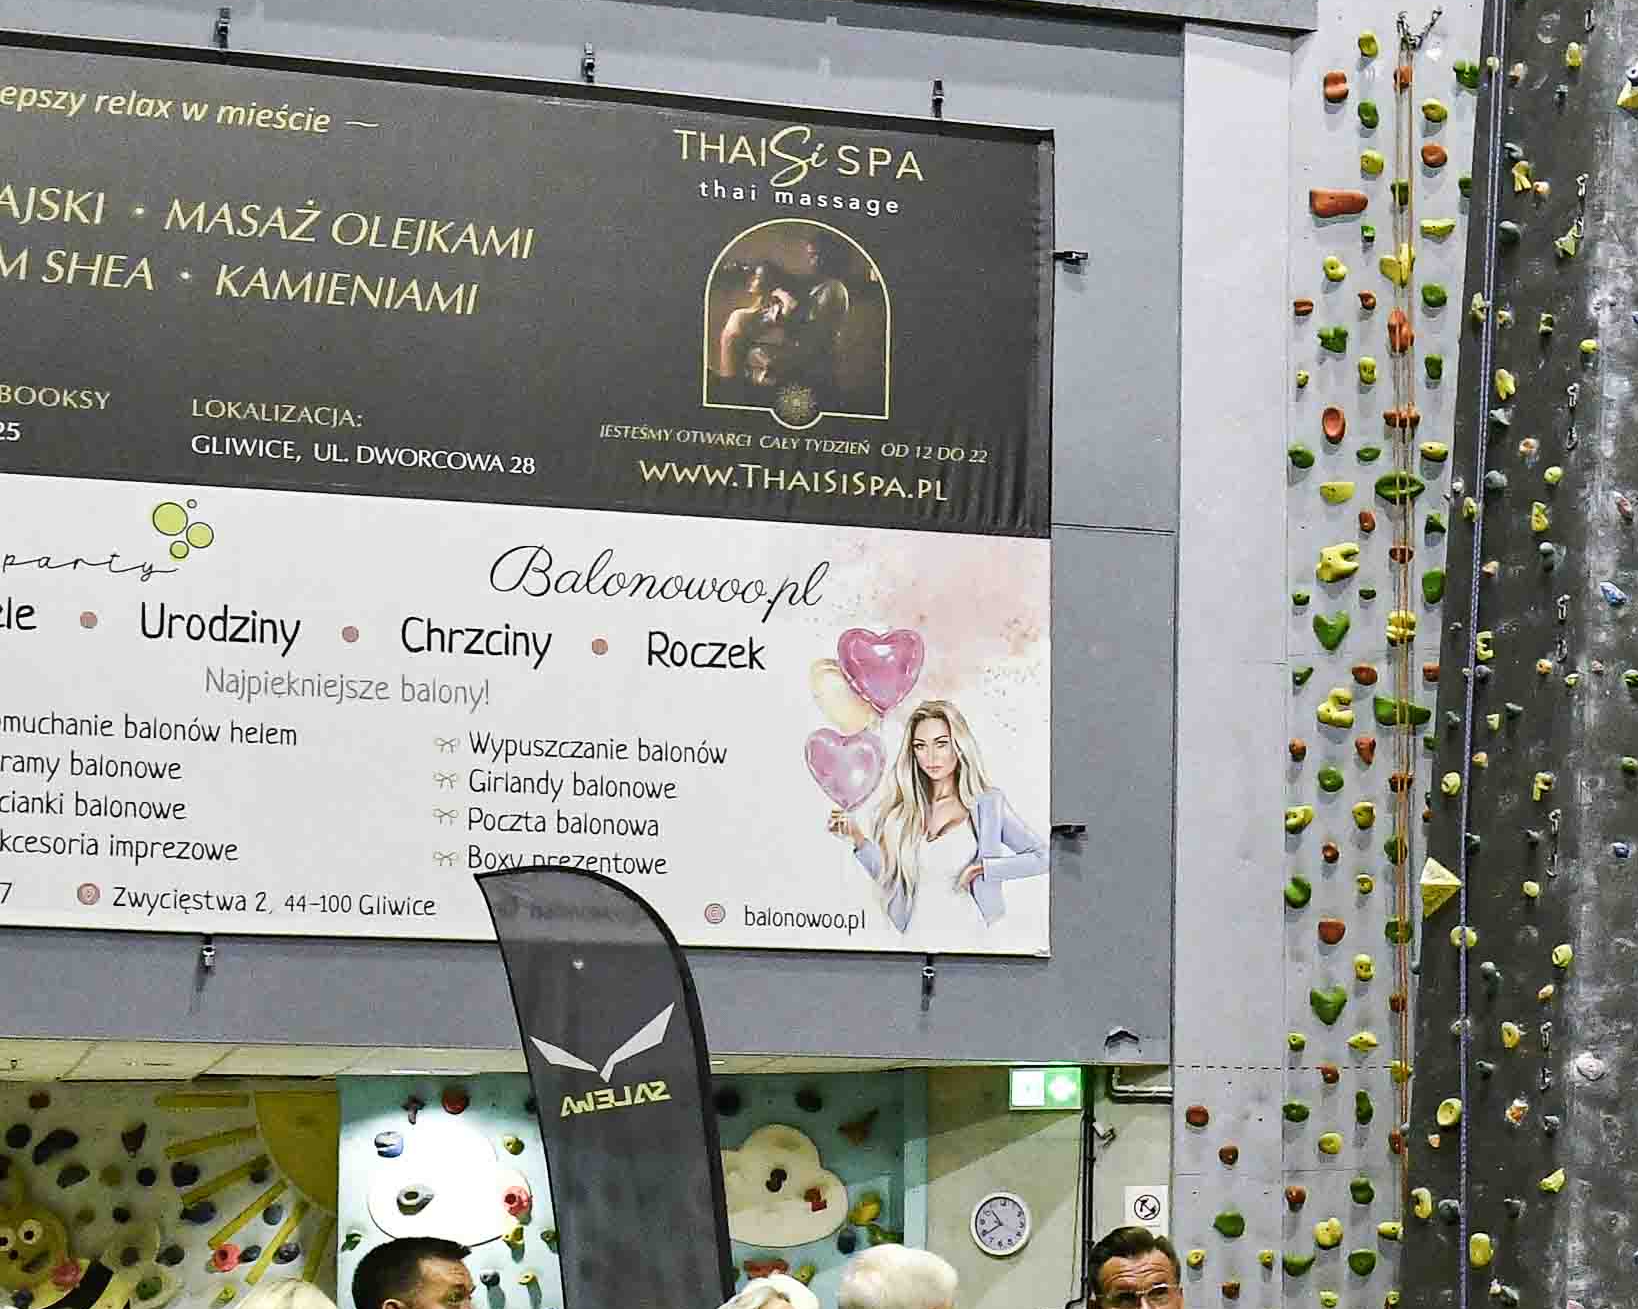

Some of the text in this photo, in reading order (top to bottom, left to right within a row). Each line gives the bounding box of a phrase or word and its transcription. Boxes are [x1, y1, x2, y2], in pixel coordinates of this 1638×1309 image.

[0, 86, 331, 133] epszy relax w mieście
[700, 179, 899, 216] thai massage
[164, 198, 320, 242] MASAŻ
[332, 211, 534, 259] OLEJKAMI
[41, 250, 154, 291] SHEA
[215, 263, 478, 315] KAMIENIAMI
[0, 384, 110, 410] BOOKSY
[193, 398, 363, 428] LOKALIZACJA:
[192, 434, 535, 475] GLIWICE, UL. DWORCOWA 28
[599, 423, 672, 442] JESTEŚMY
[676, 430, 752, 447] OTWARCI
[804, 437, 870, 455] TYDZIEŃ
[881, 443, 909, 458] OD
[914, 445, 932, 460] 12
[937, 447, 964, 462] DO
[968, 449, 988, 464] 22
[3, 554, 179, 582] party
[489, 544, 831, 623] Balonowoo.pl
[0, 596, 767, 671] le Urodziny Chrzciny Roczek
[401, 674, 489, 714] balony!
[124, 713, 221, 743] balonów
[230, 720, 298, 747] helem
[469, 731, 727, 766] Wypuszczanie balonów
[0, 750, 182, 783] ramy balonowe
[469, 769, 677, 801] Girlandy balonowe
[0, 790, 187, 820] cianki balonowe
[467, 807, 659, 837] Poczta balonowa
[0, 828, 239, 866] kcesoria imprezowe
[112, 886, 247, 916] Zwycięstwa
[284, 894, 351, 914] 44-100
[359, 894, 437, 917] Gliwice
[744, 906, 866, 934] balonowoo.pl
